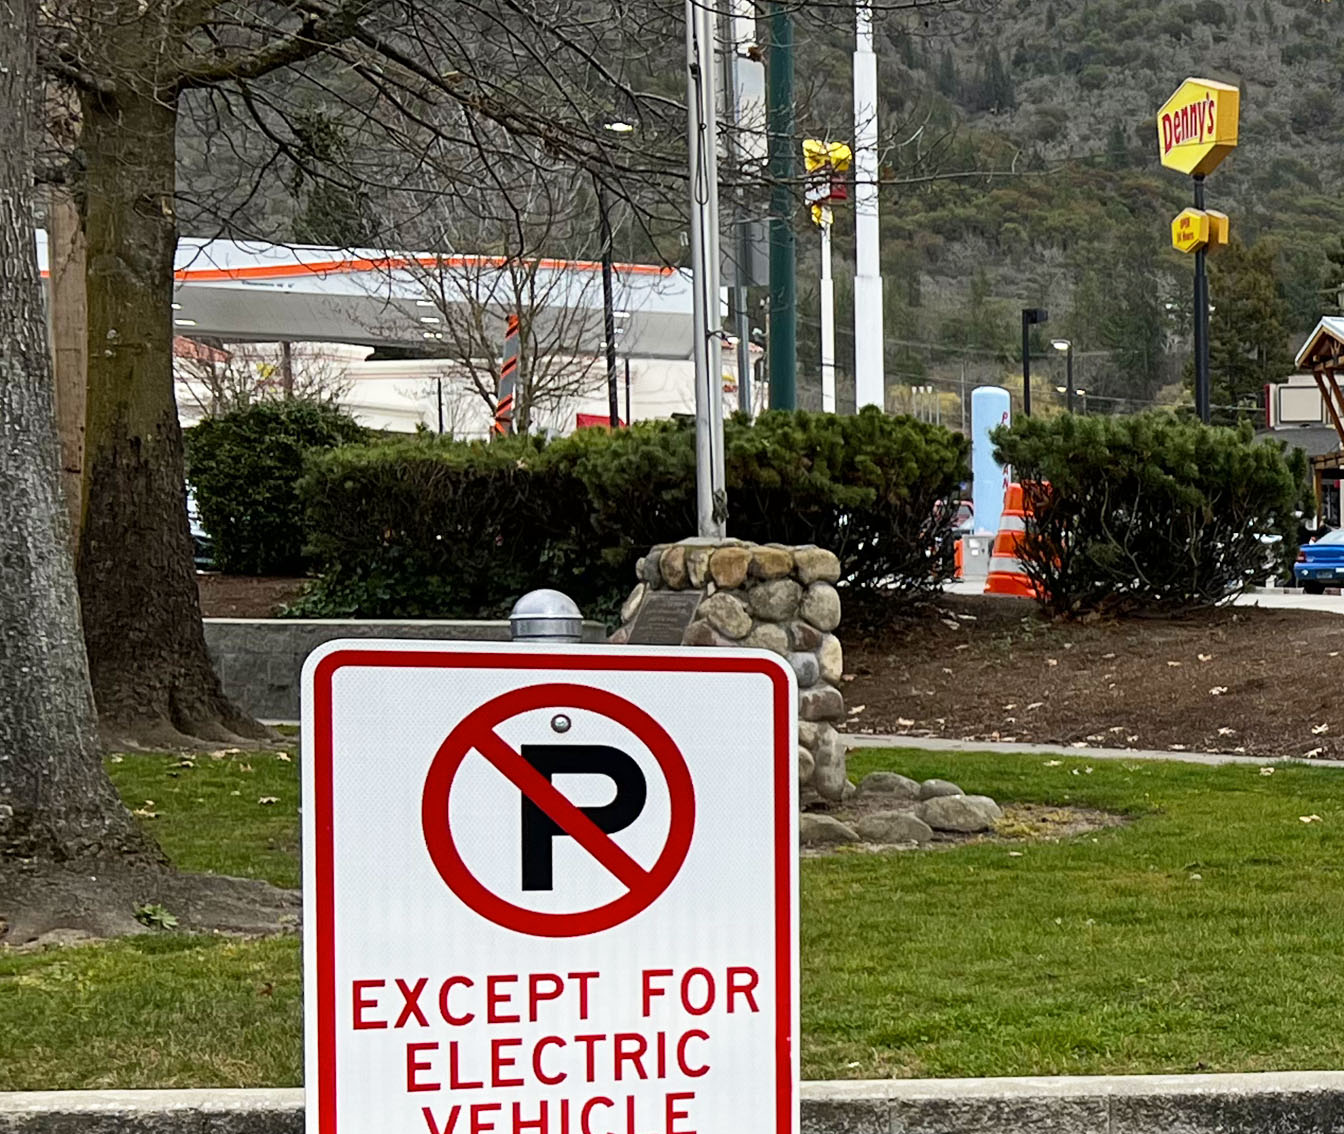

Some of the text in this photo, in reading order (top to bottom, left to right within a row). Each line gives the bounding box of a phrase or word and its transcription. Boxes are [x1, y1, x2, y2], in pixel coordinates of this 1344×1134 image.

[1162, 92, 1215, 155] Denny's
[520, 744, 648, 891] P
[352, 966, 760, 1030] EXCEPT FOR
[407, 1029, 711, 1092] ELECTRIC
